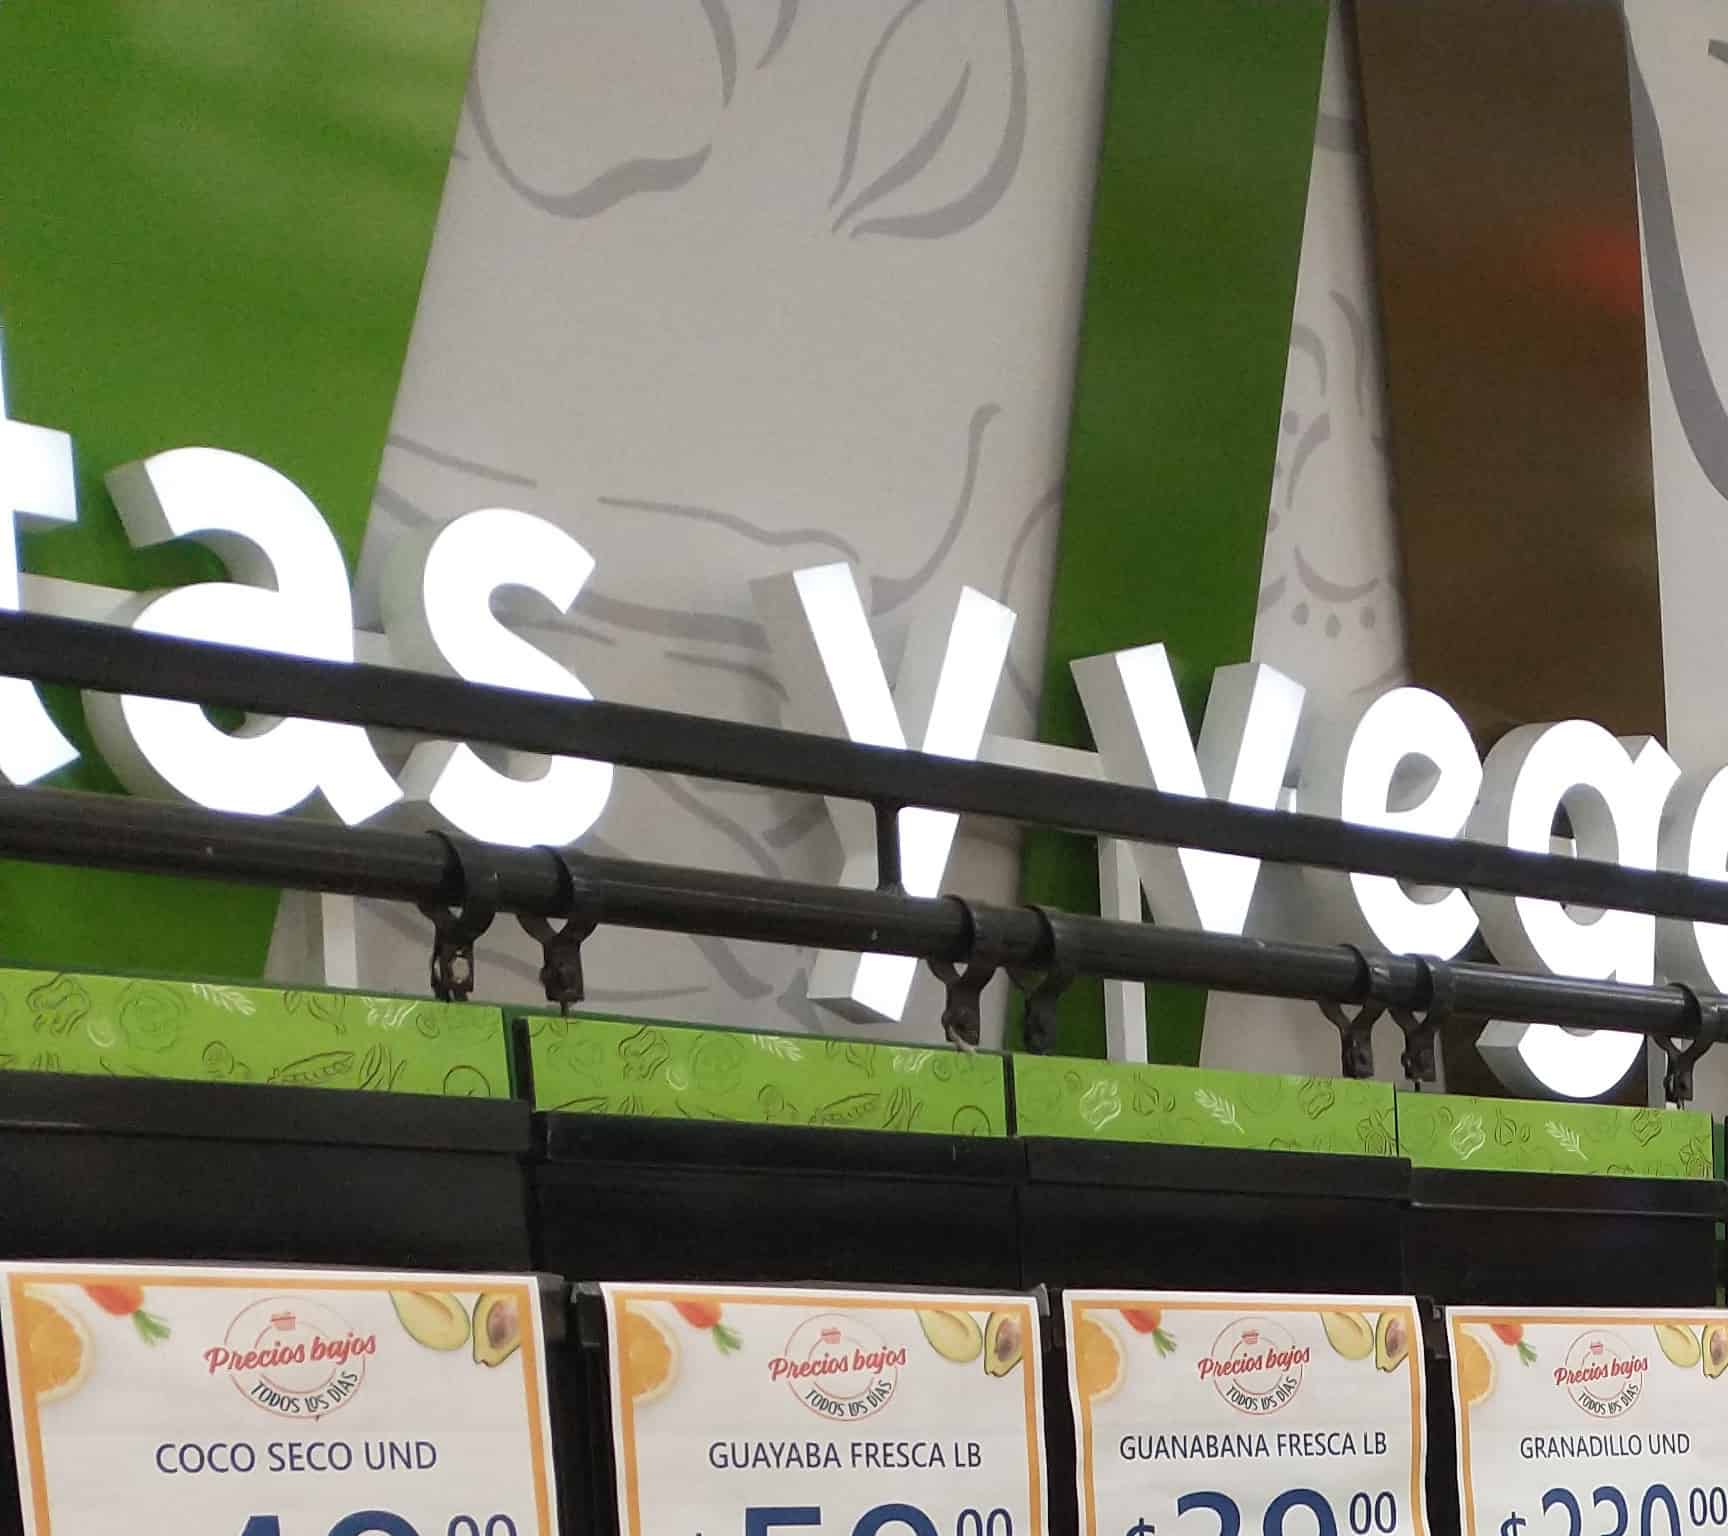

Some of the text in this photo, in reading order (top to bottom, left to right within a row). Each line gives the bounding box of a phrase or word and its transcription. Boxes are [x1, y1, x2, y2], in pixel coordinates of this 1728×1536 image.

[793, 562, 1016, 1022] y
[203, 1332, 377, 1376] Precios bajos
[768, 1346, 907, 1382] Precios bajos
[1197, 1345, 1312, 1380] Precios bajos
[250, 1381, 301, 1414] TODOS
[155, 1440, 438, 1473] COCO SECO UND
[708, 1441, 982, 1469] GUAYABA FRESCA LB
[1119, 1431, 1388, 1460] GUANABANA FRESCA LB
[1520, 1433, 1690, 1460] GRANADILLO UND
[1349, 1491, 1397, 1535] 00
[1689, 1486, 1728, 1527] 00
